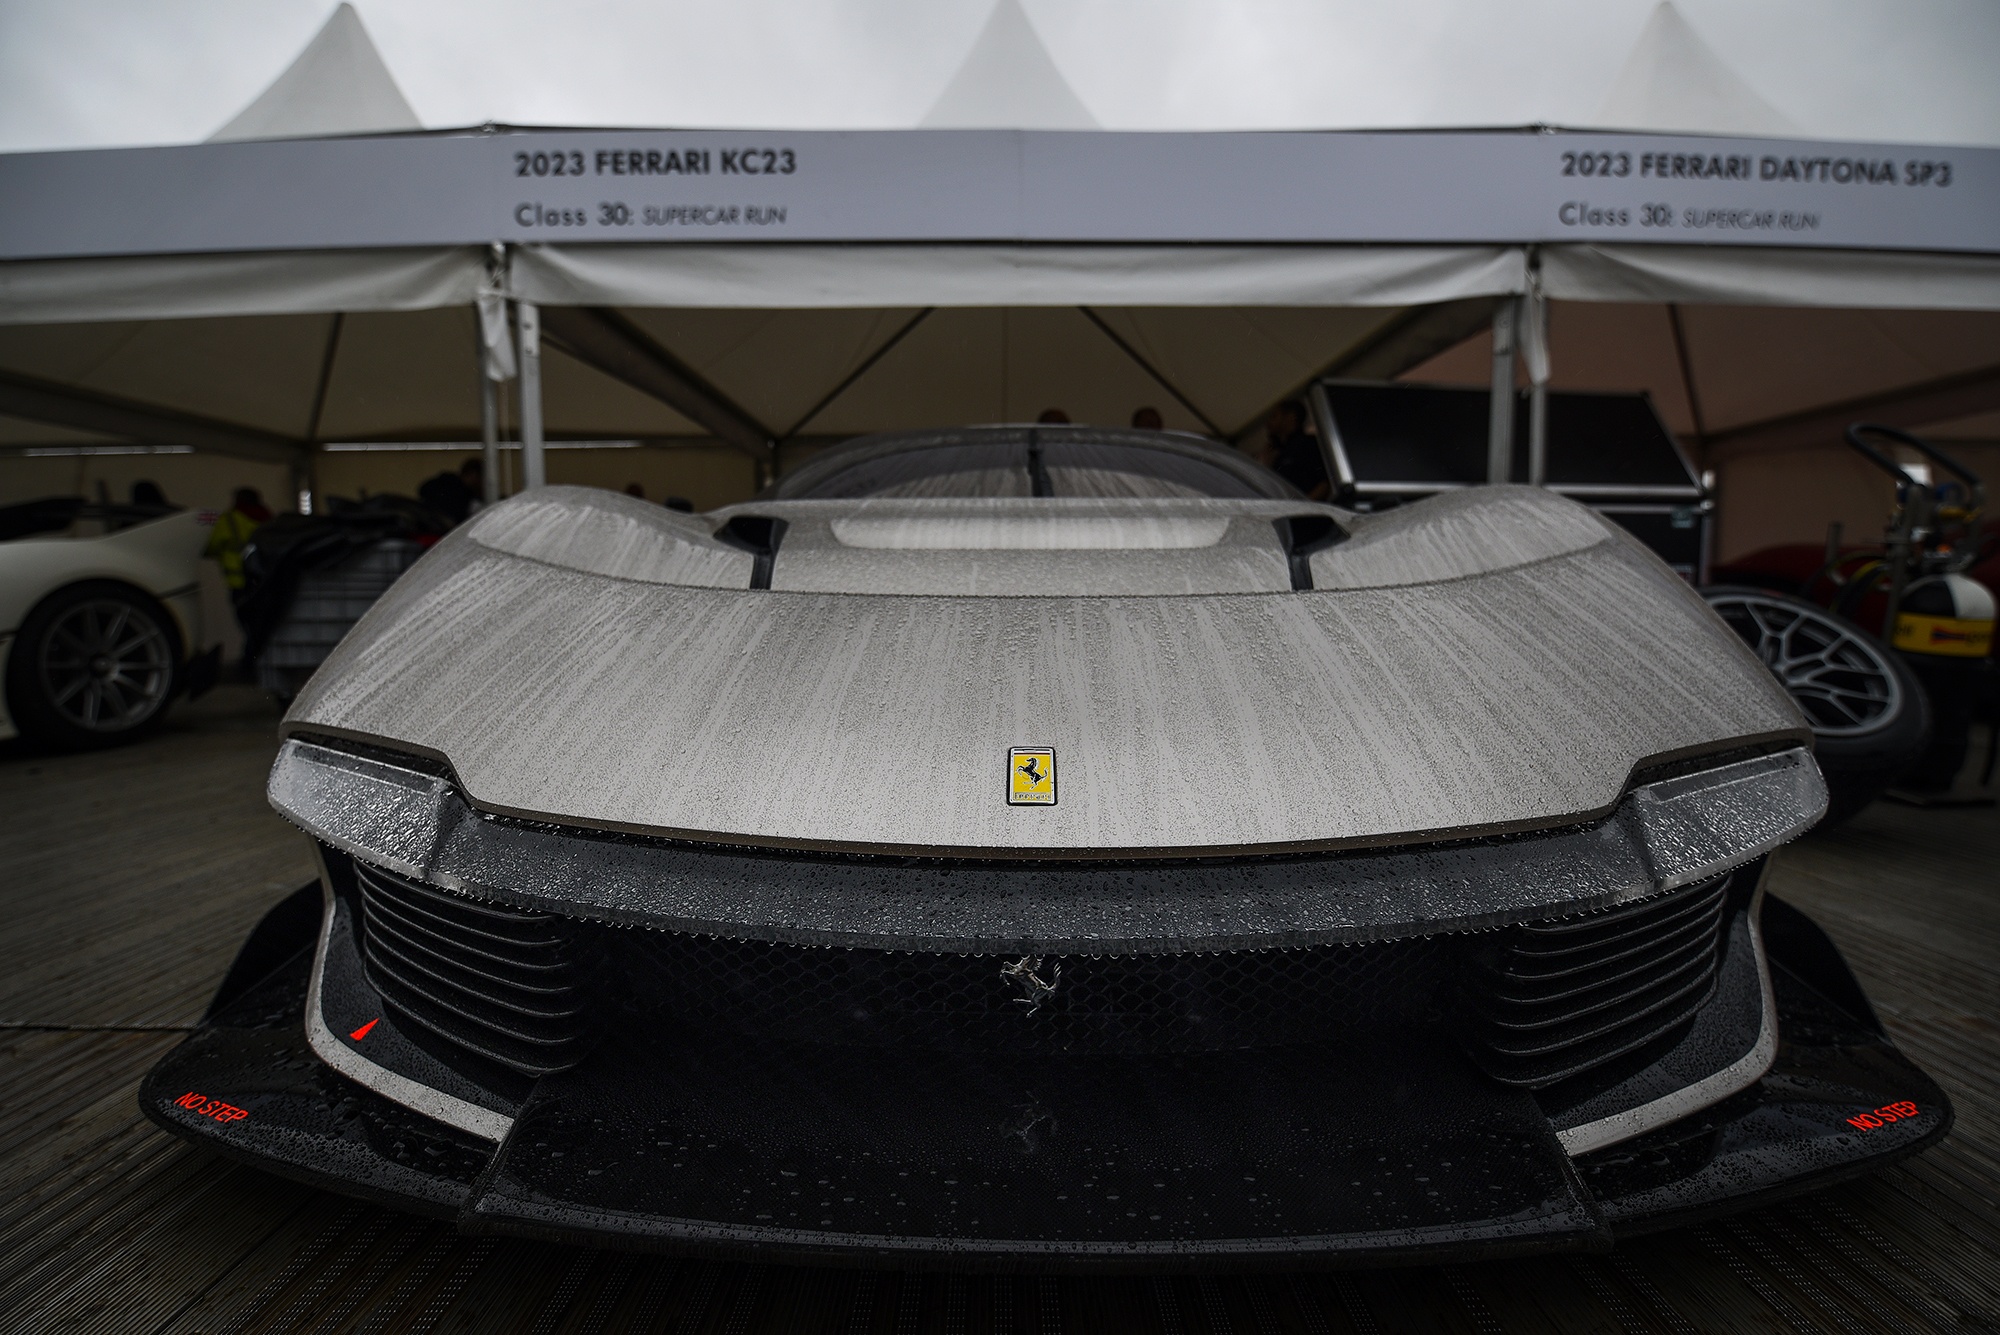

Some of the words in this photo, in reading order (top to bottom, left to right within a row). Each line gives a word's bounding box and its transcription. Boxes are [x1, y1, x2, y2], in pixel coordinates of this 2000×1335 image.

[515, 151, 586, 177] 2023
[595, 149, 710, 176] FERRARI
[720, 149, 797, 175] KC23
[1561, 152, 1632, 178] 2023
[1639, 153, 1751, 181] FERRARI
[1759, 156, 1898, 185] DAYTONA
[1903, 160, 1952, 187] SP3
[514, 202, 587, 227] Class
[598, 202, 635, 226] 30:
[641, 205, 741, 226] SUPERCAR
[743, 206, 788, 225] RUN
[1558, 202, 1630, 226] Class
[1638, 204, 1674, 227] 30:
[1681, 207, 1774, 230] SUPERCAR
[1776, 210, 1821, 231] RUN
[173, 1091, 208, 1110] NO
[197, 1100, 249, 1123] STEP
[1846, 1113, 1884, 1132] NO
[1873, 1100, 1920, 1123] STEP
